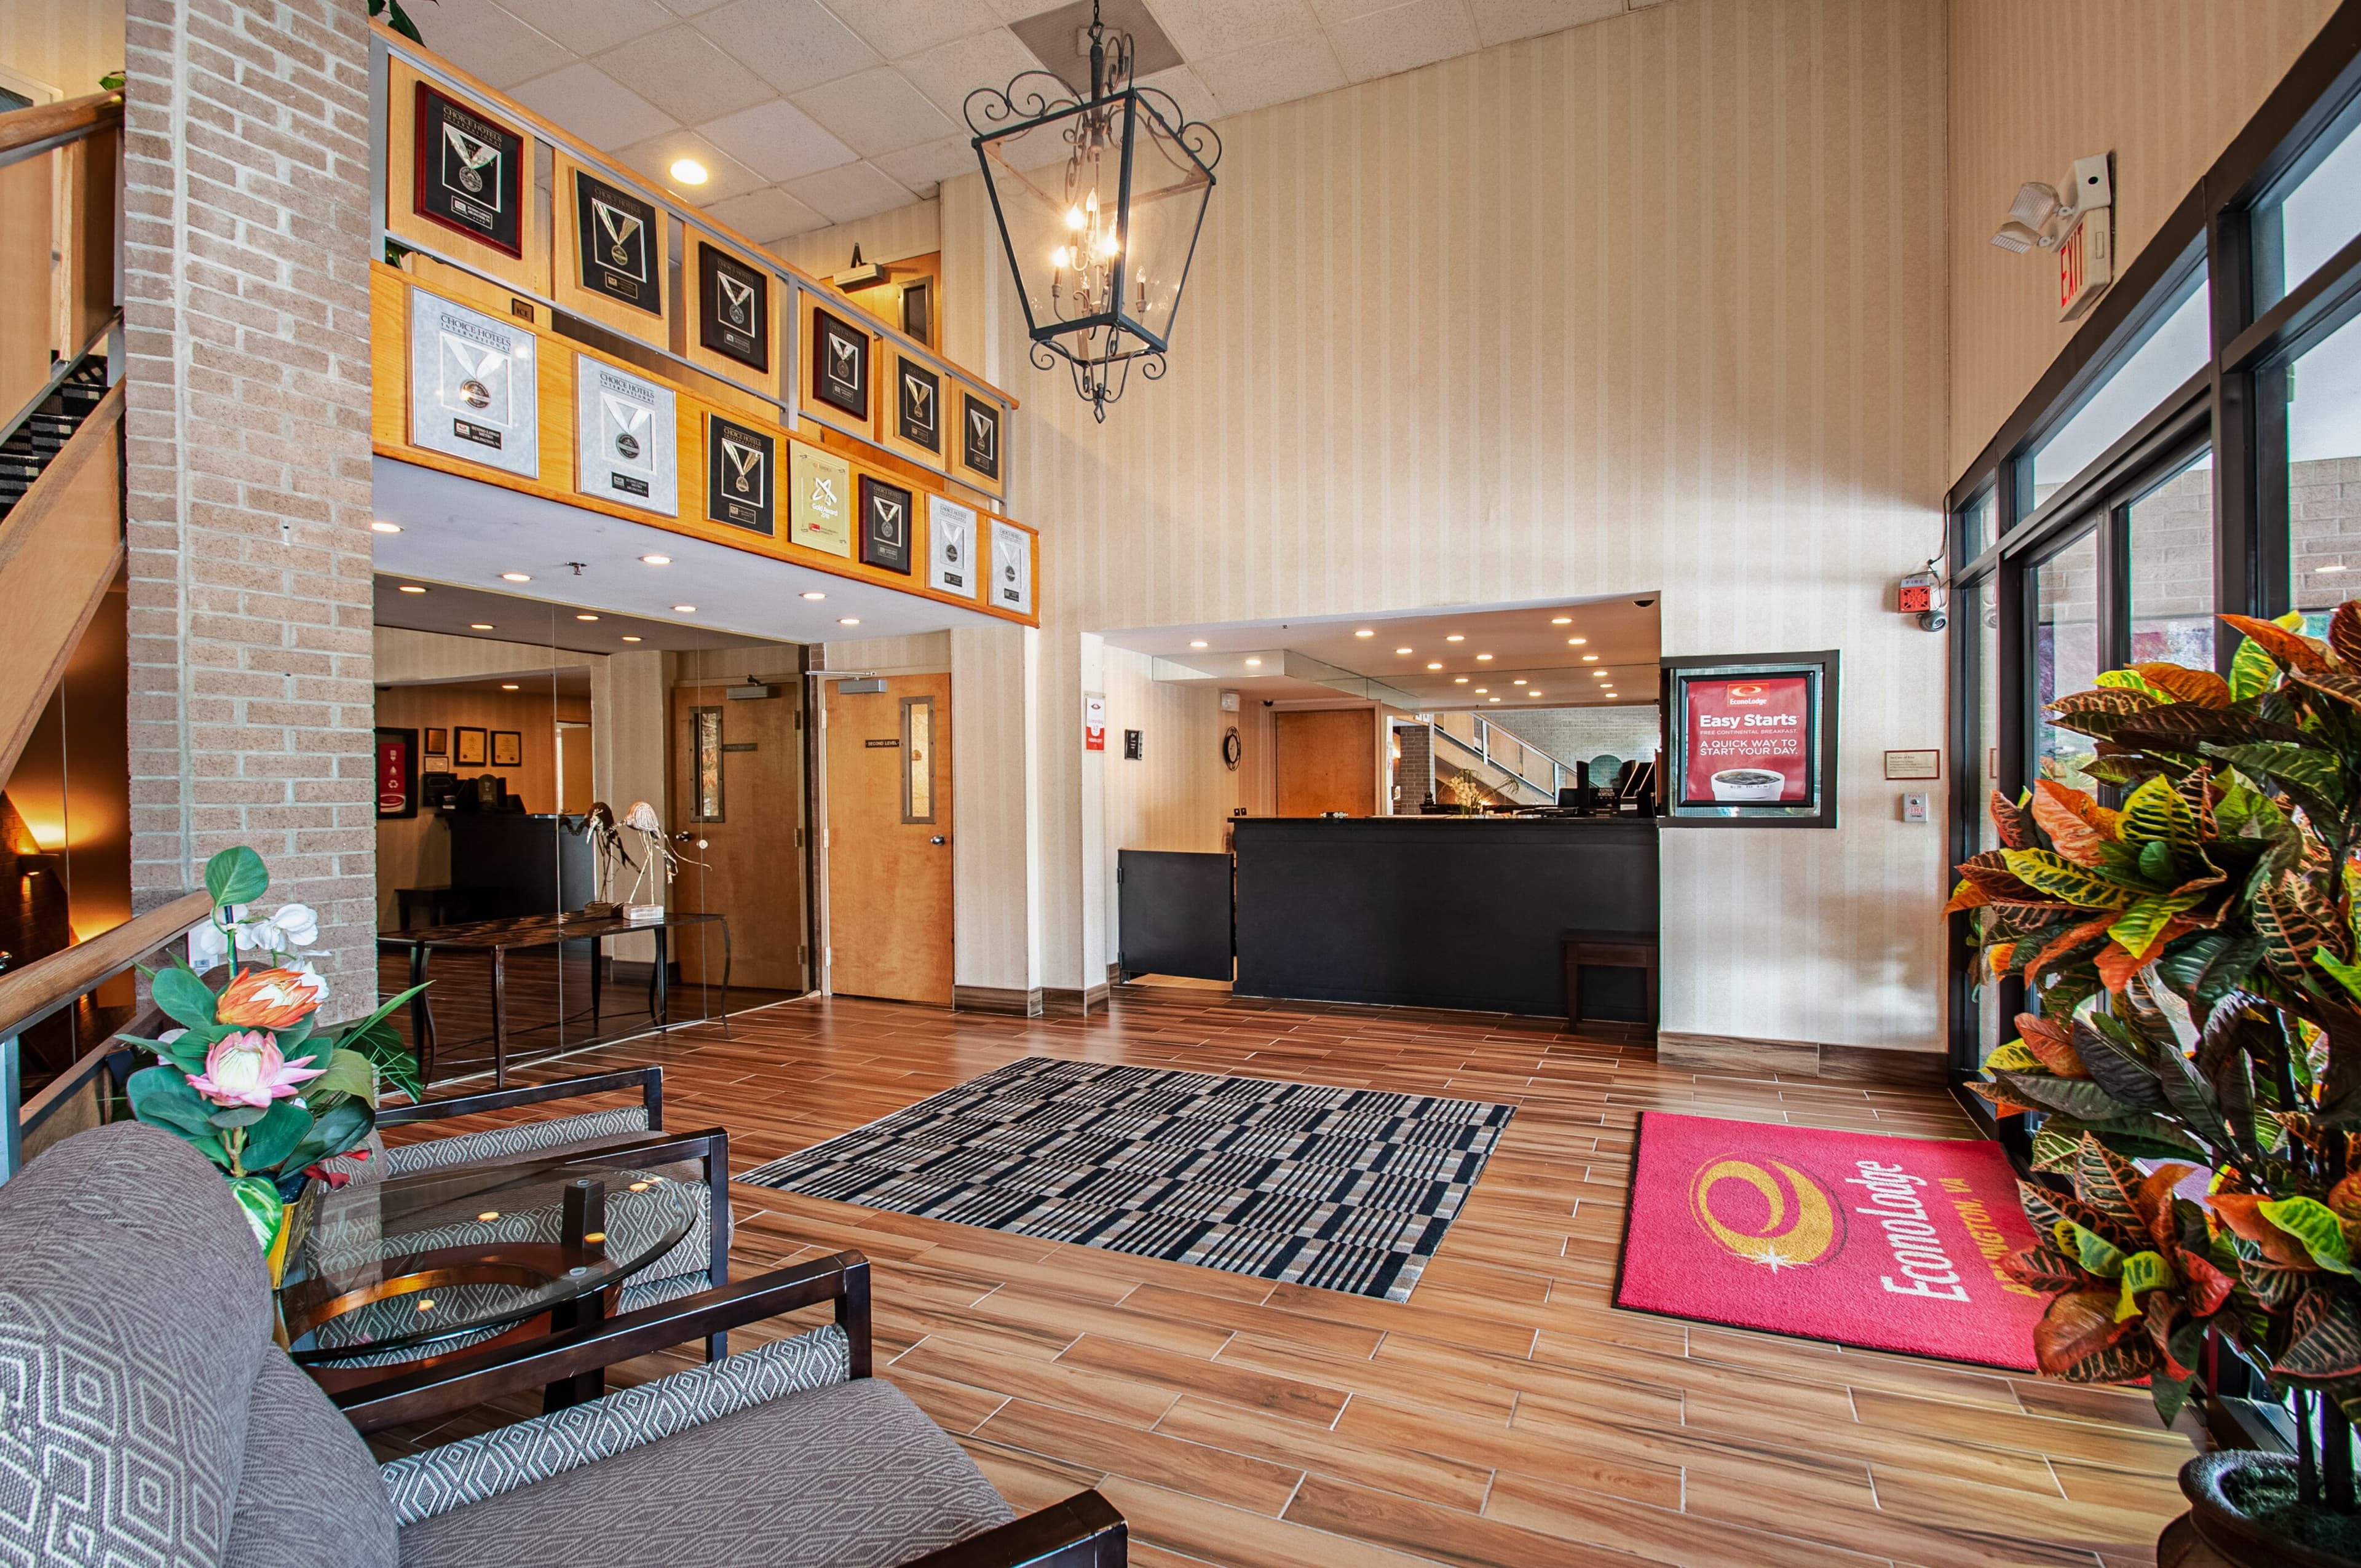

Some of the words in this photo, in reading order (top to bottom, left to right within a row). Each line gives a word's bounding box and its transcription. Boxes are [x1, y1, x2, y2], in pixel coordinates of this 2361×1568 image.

[443, 107, 472, 125] CHOICE
[474, 123, 502, 143] HOTELS
[2060, 222, 2084, 308] EXIT
[516, 307, 529, 317] ICE
[441, 315, 476, 333] CHOICE
[478, 328, 512, 347] HOTELS
[441, 322, 510, 352] INTERNATIONAL
[600, 373, 627, 389] CHOICE
[628, 383, 655, 398] HOTELS
[600, 379, 654, 403] INTERNATIONAL
[724, 428, 742, 439] CHOICE
[743, 435, 762, 446] HOTELS
[1700, 715, 1741, 729] Easy
[1744, 713, 1798, 726] Starts
[1938, 1178, 1972, 1193] VA
[1845, 1160, 1971, 1302] EconoLodge
